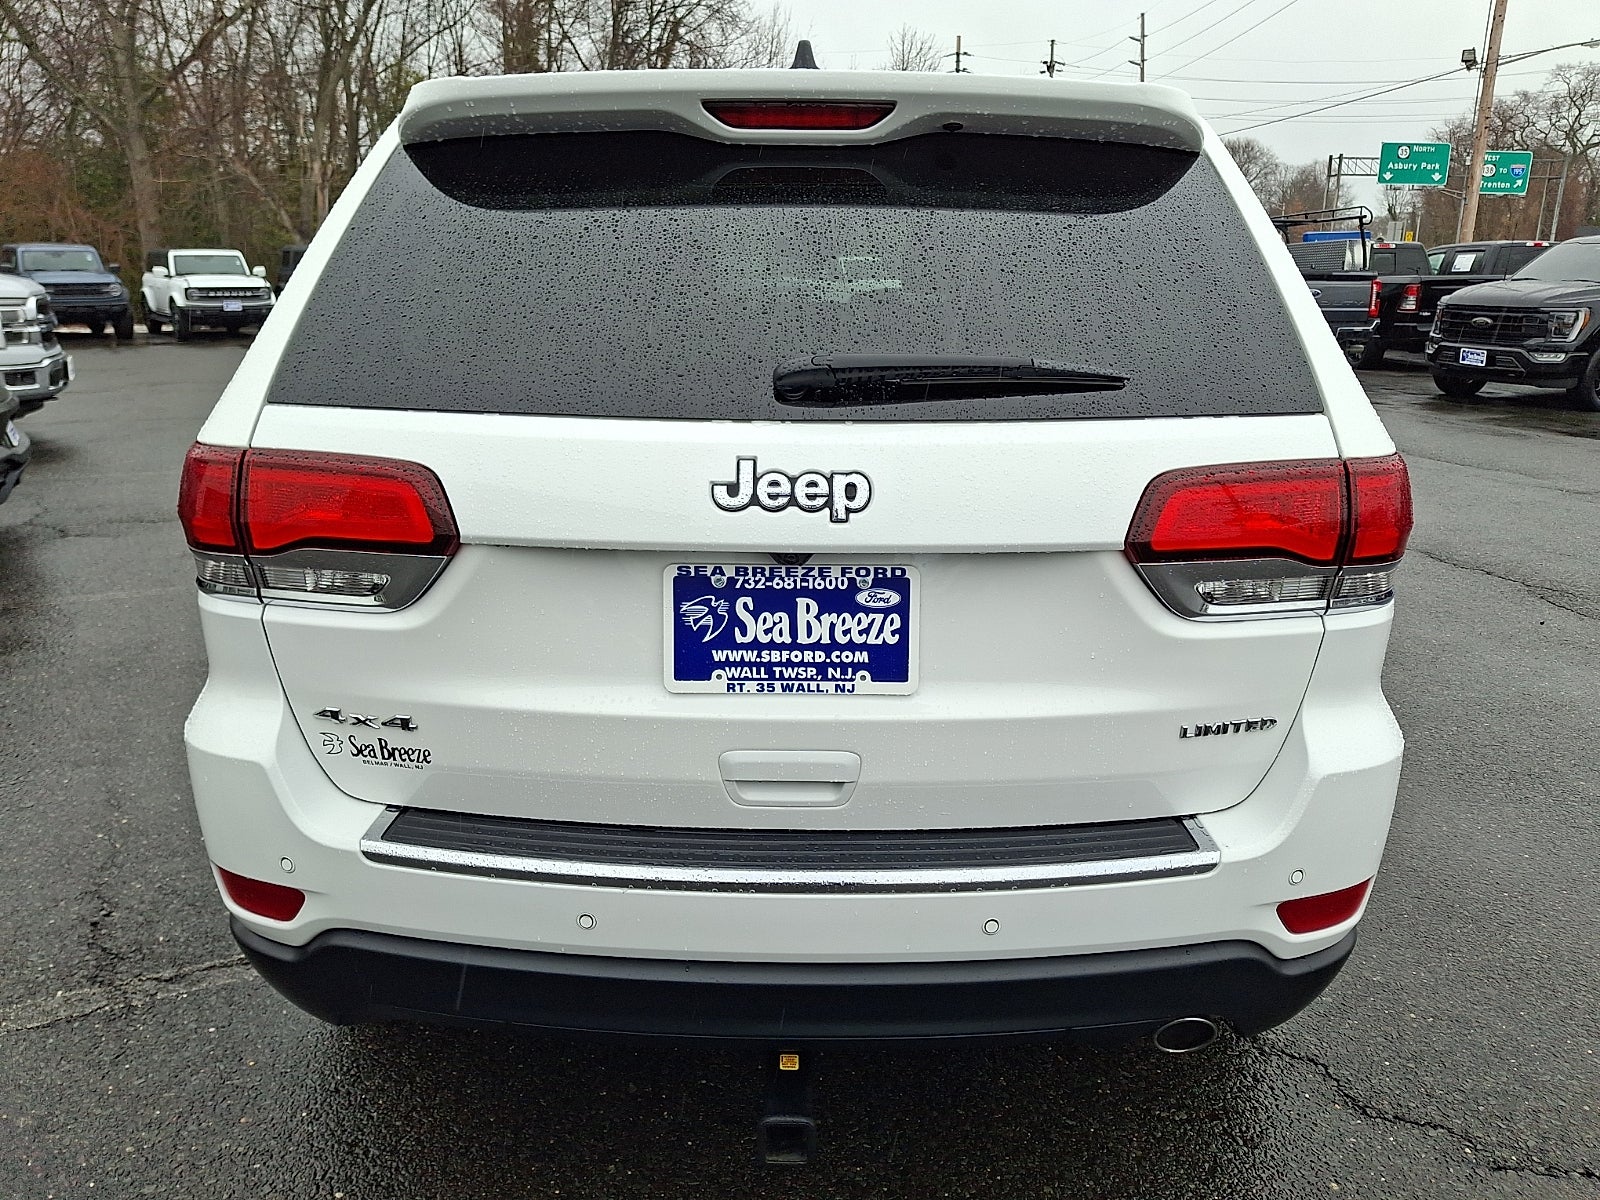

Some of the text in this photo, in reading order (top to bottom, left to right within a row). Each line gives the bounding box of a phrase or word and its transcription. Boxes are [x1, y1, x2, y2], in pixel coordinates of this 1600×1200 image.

[1400, 148, 1408, 156] 35
[1388, 161, 1440, 171] Asbury Park
[710, 455, 872, 523] Jeep
[676, 565, 907, 578] SEA BREEZE FORD
[734, 577, 848, 590] 732-681-1600
[864, 591, 891, 605] Ford
[734, 596, 901, 645] Sea Breeze
[711, 649, 869, 663] WWW.SBFORD.COM
[725, 666, 769, 679] WALL
[827, 667, 856, 680] N.J.
[726, 682, 856, 694] RT. 35 WALL, NJ
[1179, 717, 1278, 739] LIMITED
[348, 735, 432, 765] Sea Breeze
